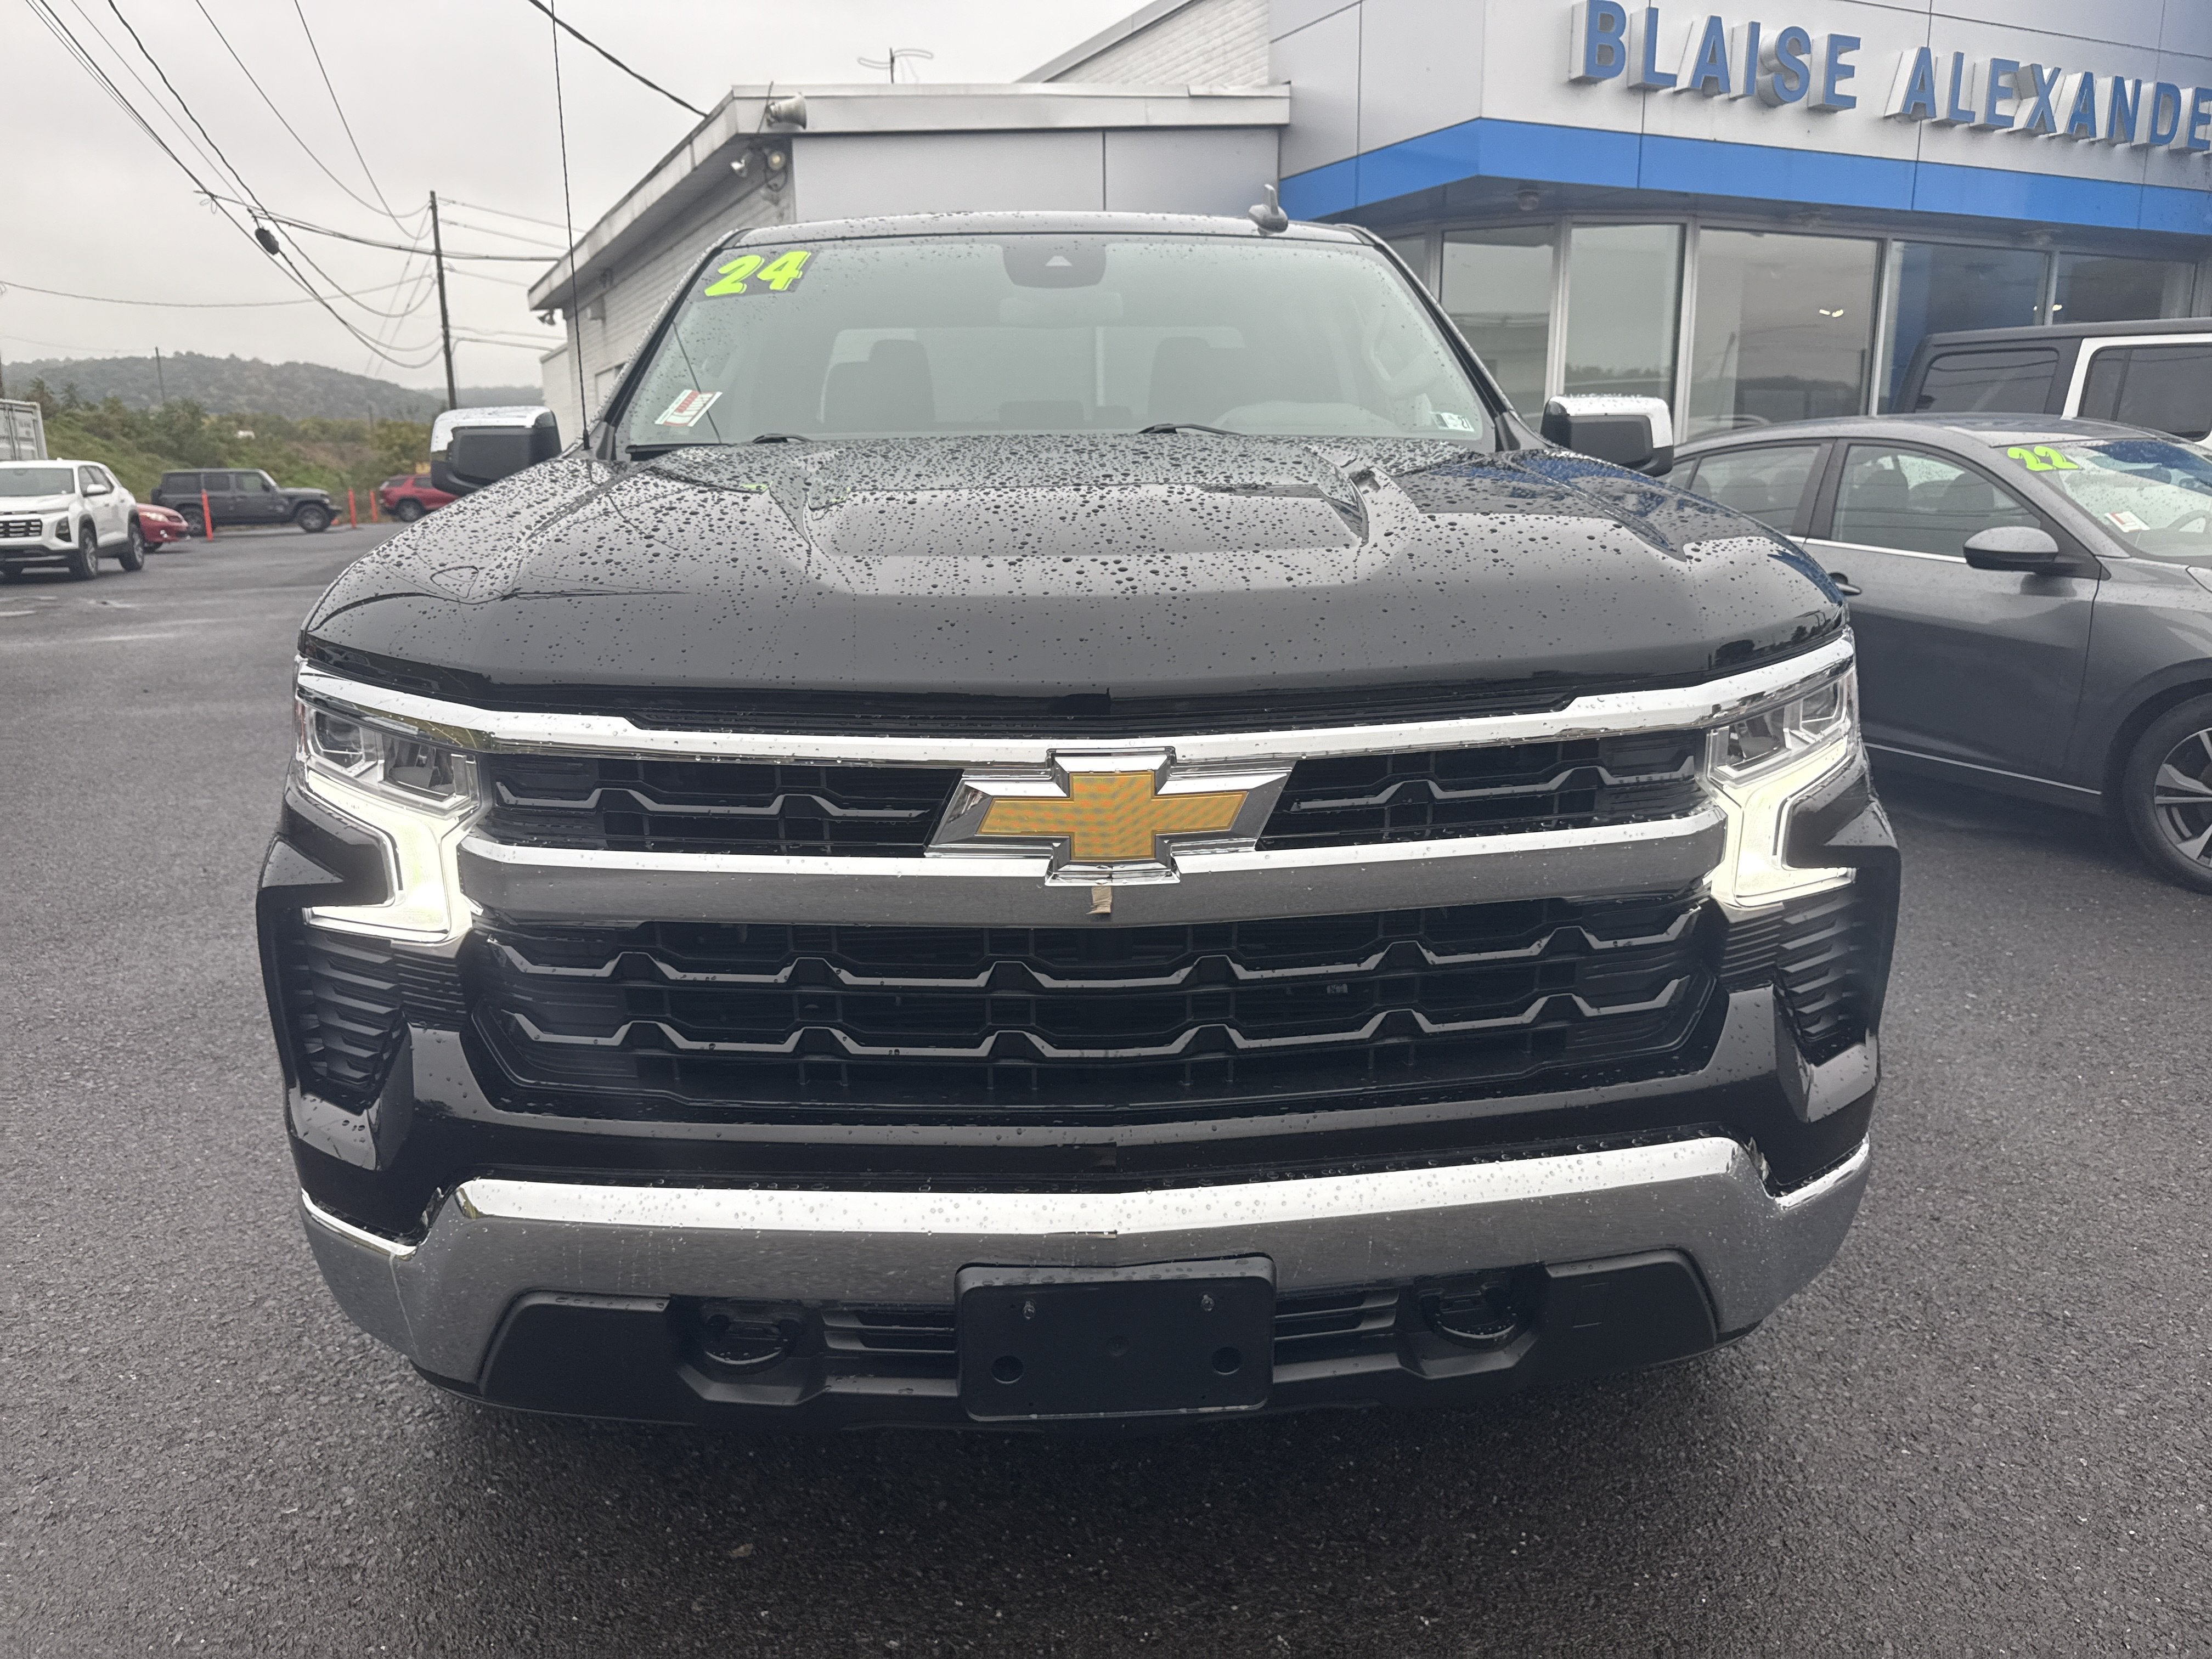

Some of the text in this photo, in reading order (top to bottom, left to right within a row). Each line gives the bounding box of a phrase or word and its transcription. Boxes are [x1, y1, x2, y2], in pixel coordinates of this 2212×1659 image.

[1583, 0, 2212, 152] BLAISE ALEXANDE
[704, 250, 811, 296] 24
[2007, 446, 2079, 471] 22
